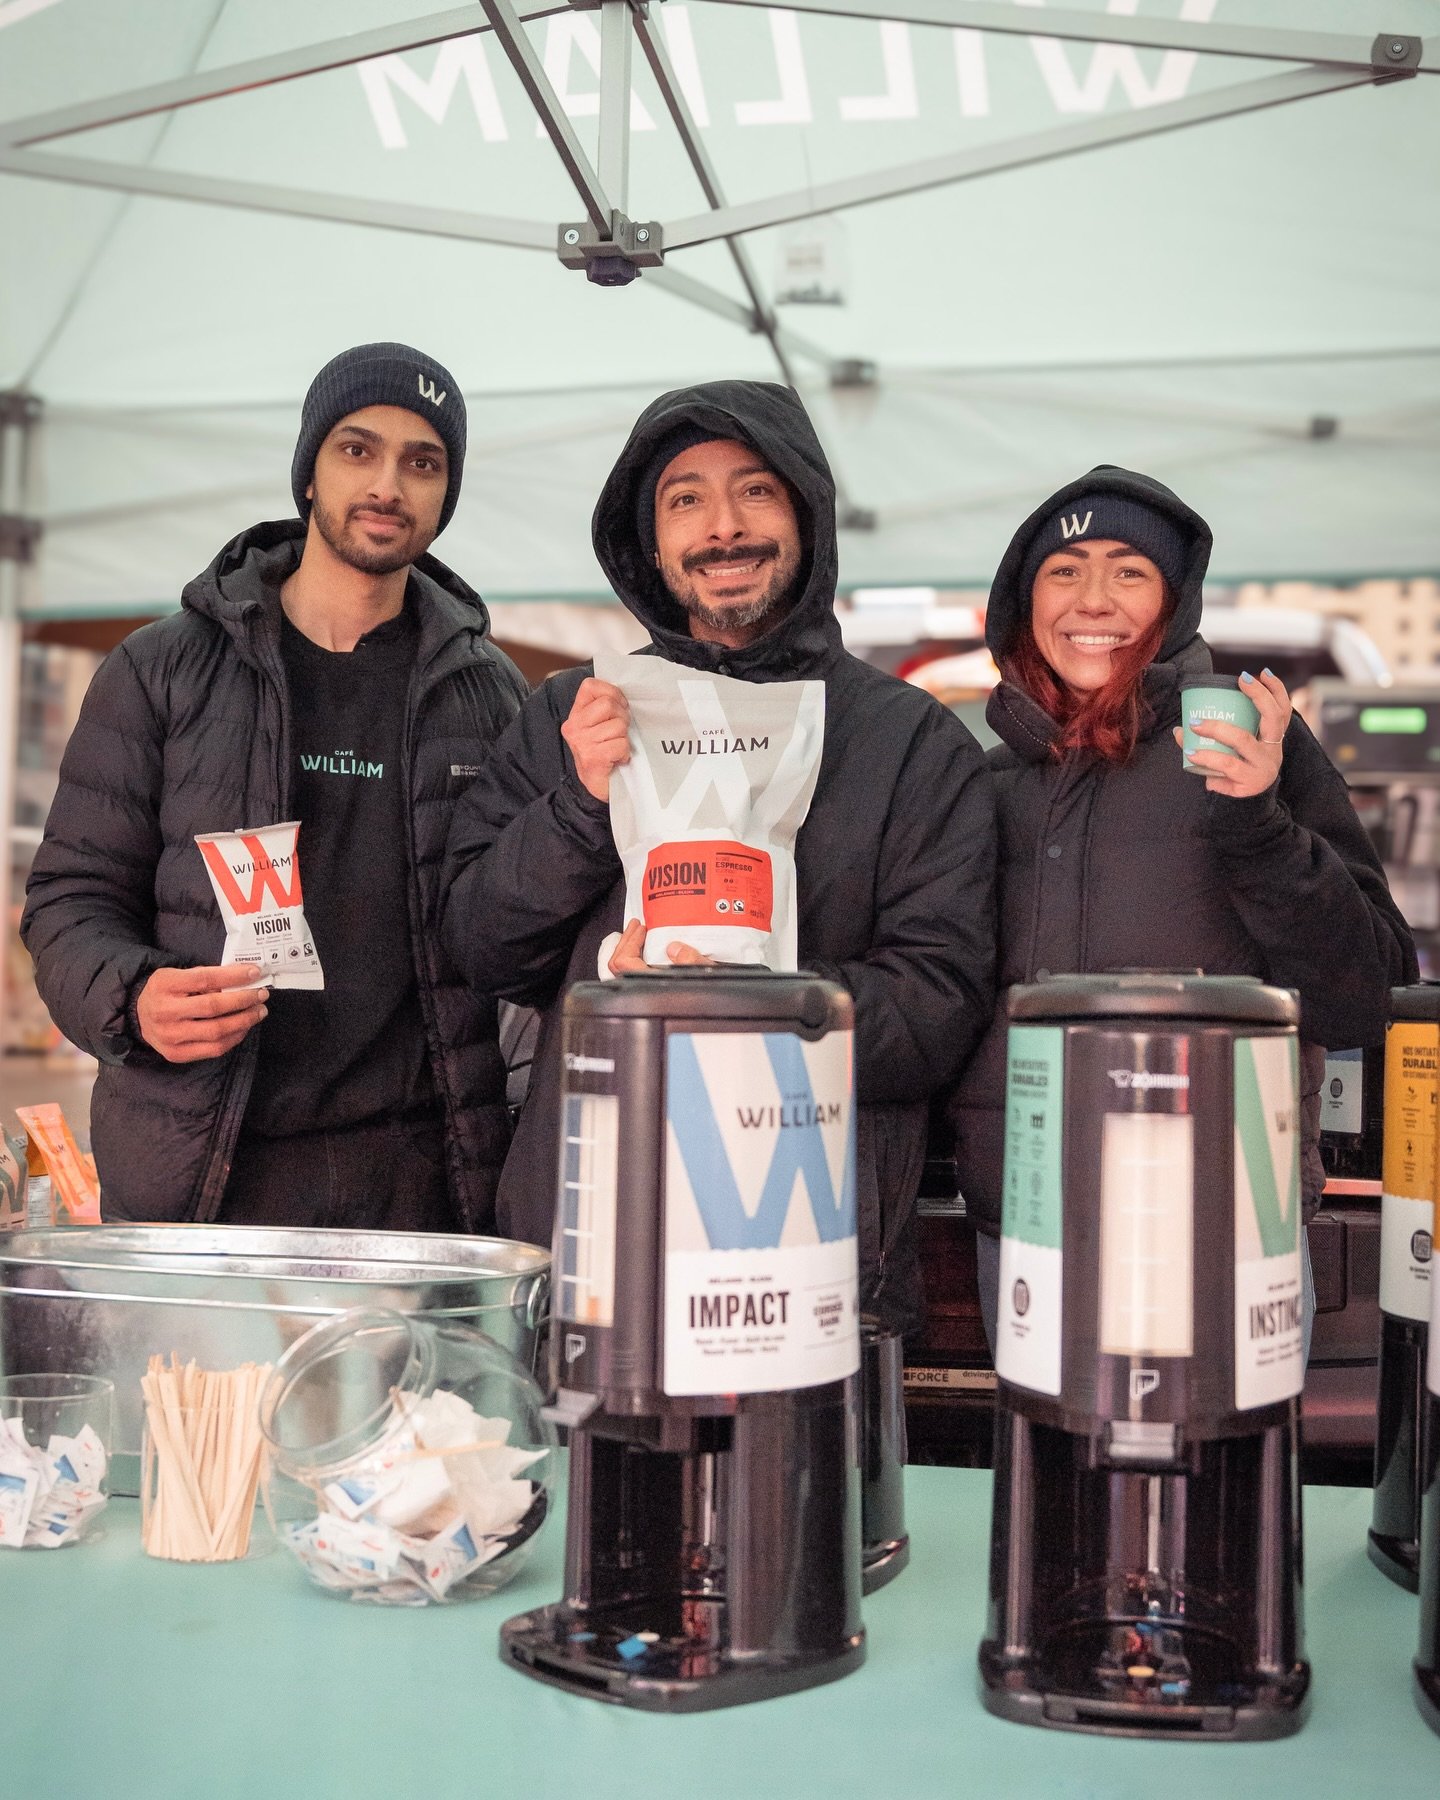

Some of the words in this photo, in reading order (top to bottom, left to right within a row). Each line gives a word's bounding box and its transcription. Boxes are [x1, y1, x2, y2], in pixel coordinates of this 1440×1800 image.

[418, 373, 447, 406] W
[1060, 511, 1093, 539] W
[1189, 710, 1235, 721] WILLIAM
[702, 728, 726, 736] CAFÉ
[661, 736, 769, 755] WILLIAM
[300, 755, 384, 778] WILLIAM
[232, 856, 291, 875] WILLIAM
[715, 861, 754, 873] ESPRESSO
[648, 861, 707, 890] VISION
[253, 917, 291, 936] VISION
[737, 1102, 841, 1128] WILLIAM
[688, 1291, 790, 1328] IMPACT
[910, 1372, 949, 1382] FORCE
